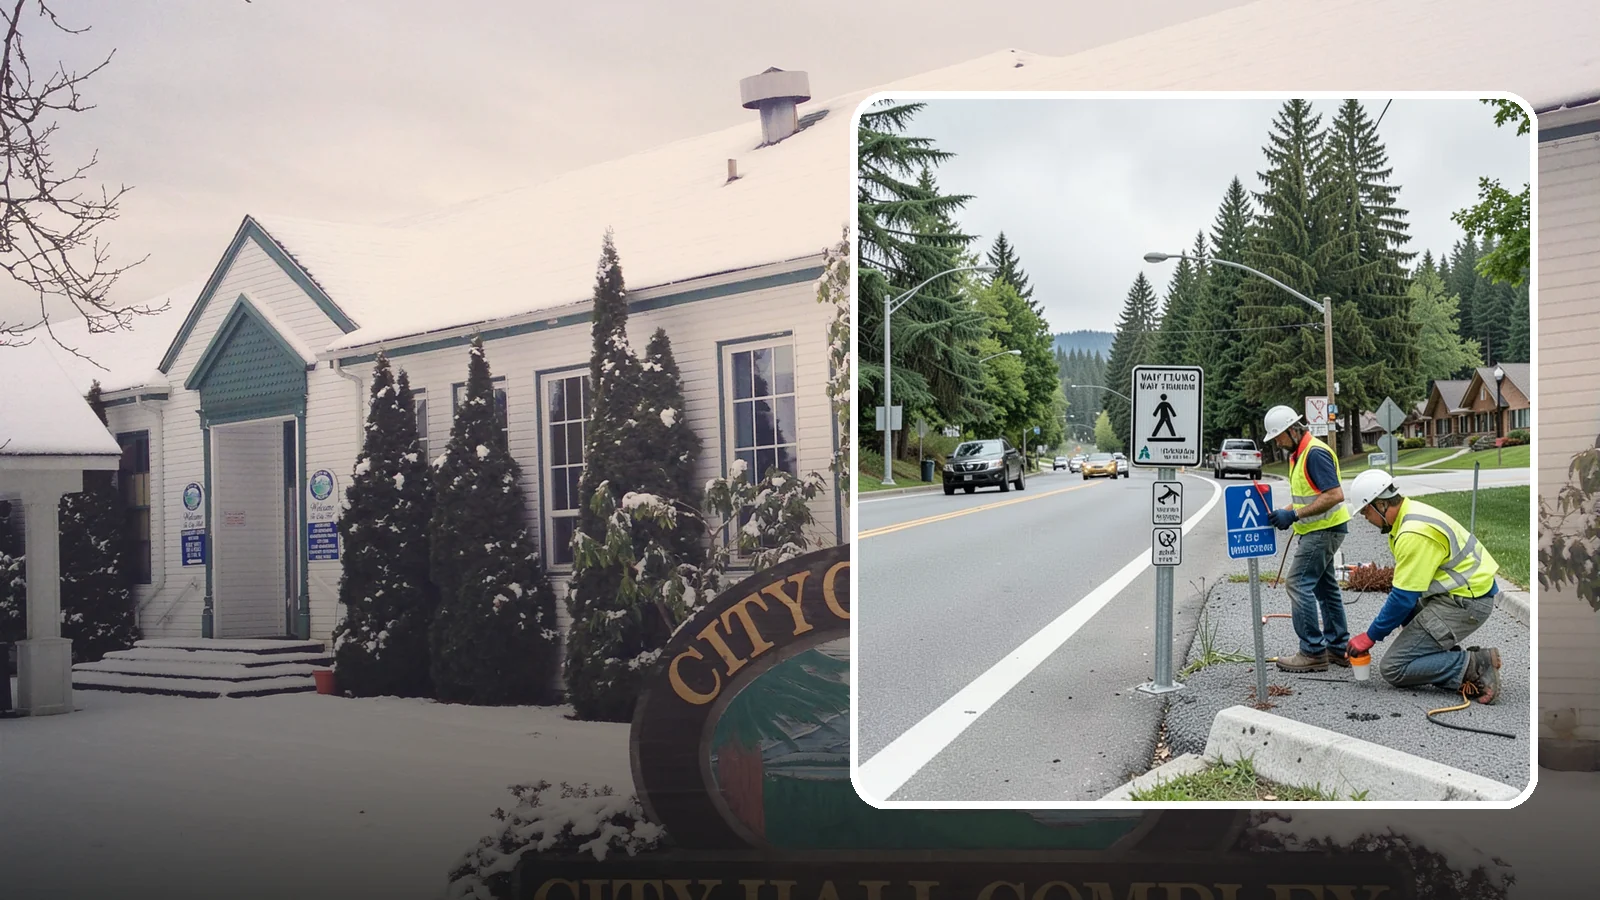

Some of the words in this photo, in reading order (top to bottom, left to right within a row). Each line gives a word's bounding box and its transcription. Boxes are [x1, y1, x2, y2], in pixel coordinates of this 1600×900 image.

[310, 502, 334, 512] Welcome
[183, 512, 203, 520] Welcome
[668, 570, 814, 705] CITY
